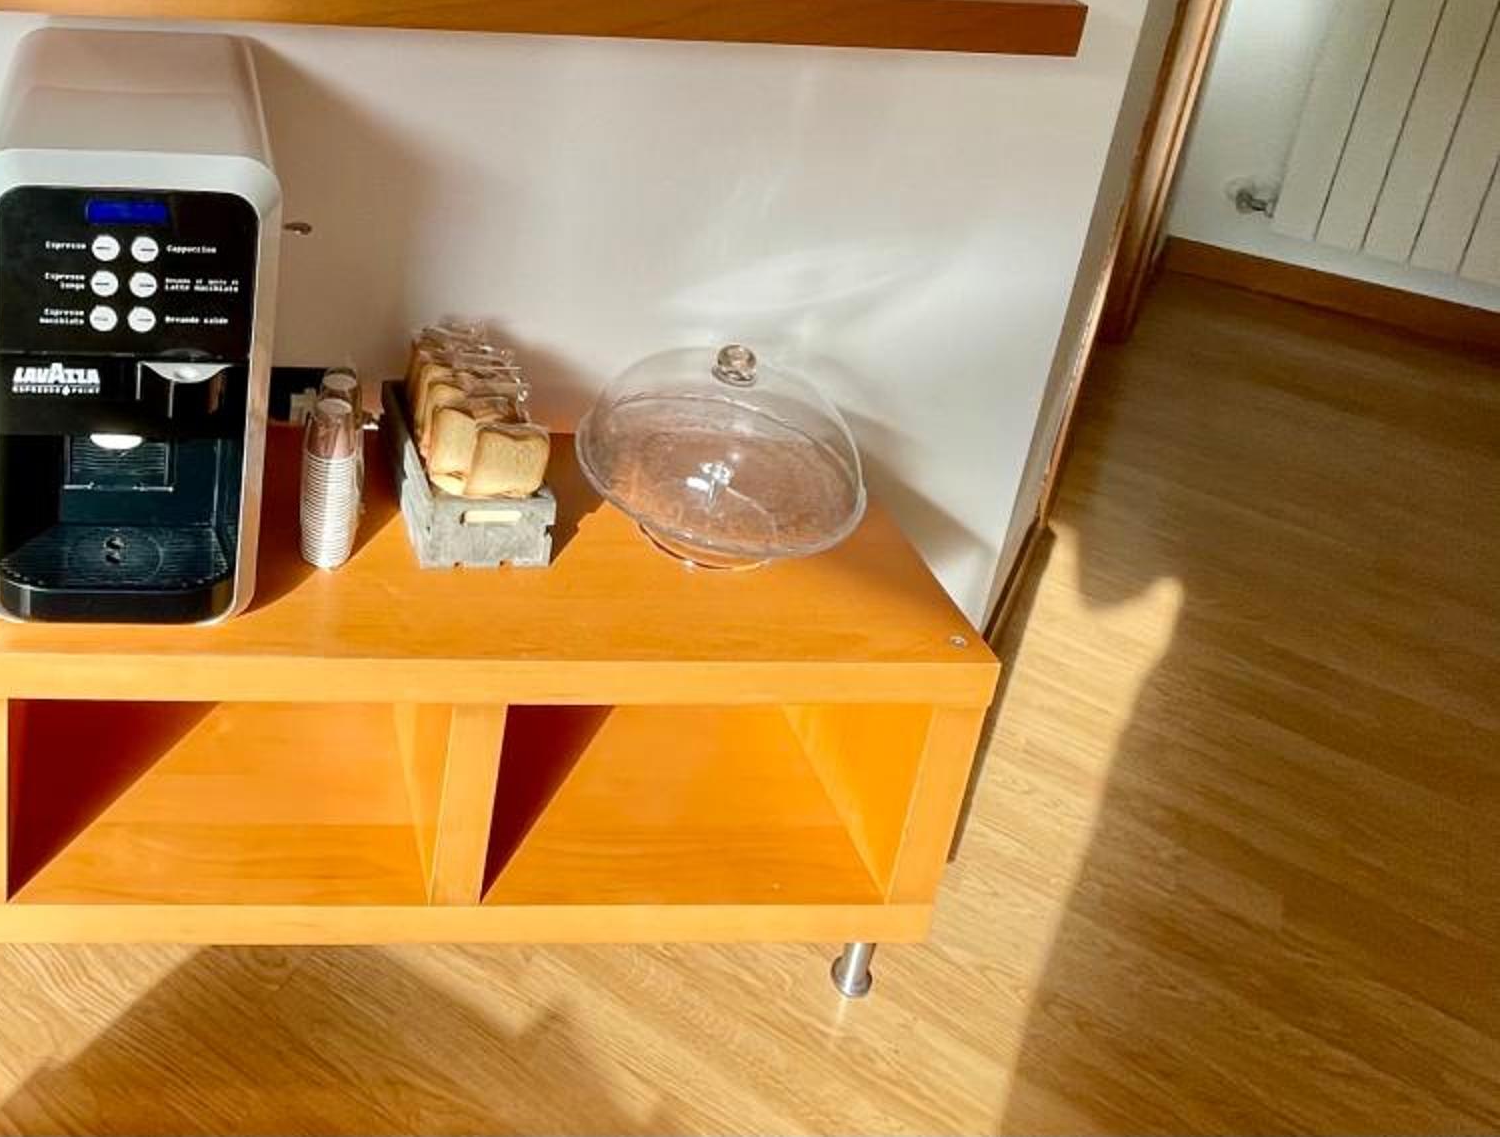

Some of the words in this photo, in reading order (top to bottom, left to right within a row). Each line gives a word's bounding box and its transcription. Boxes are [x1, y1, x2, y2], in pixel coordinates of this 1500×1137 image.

[45, 241, 86, 251] Espresso
[45, 272, 85, 281] Espresso
[44, 308, 84, 317] Espresso
[12, 363, 100, 384] LAVAZZA
